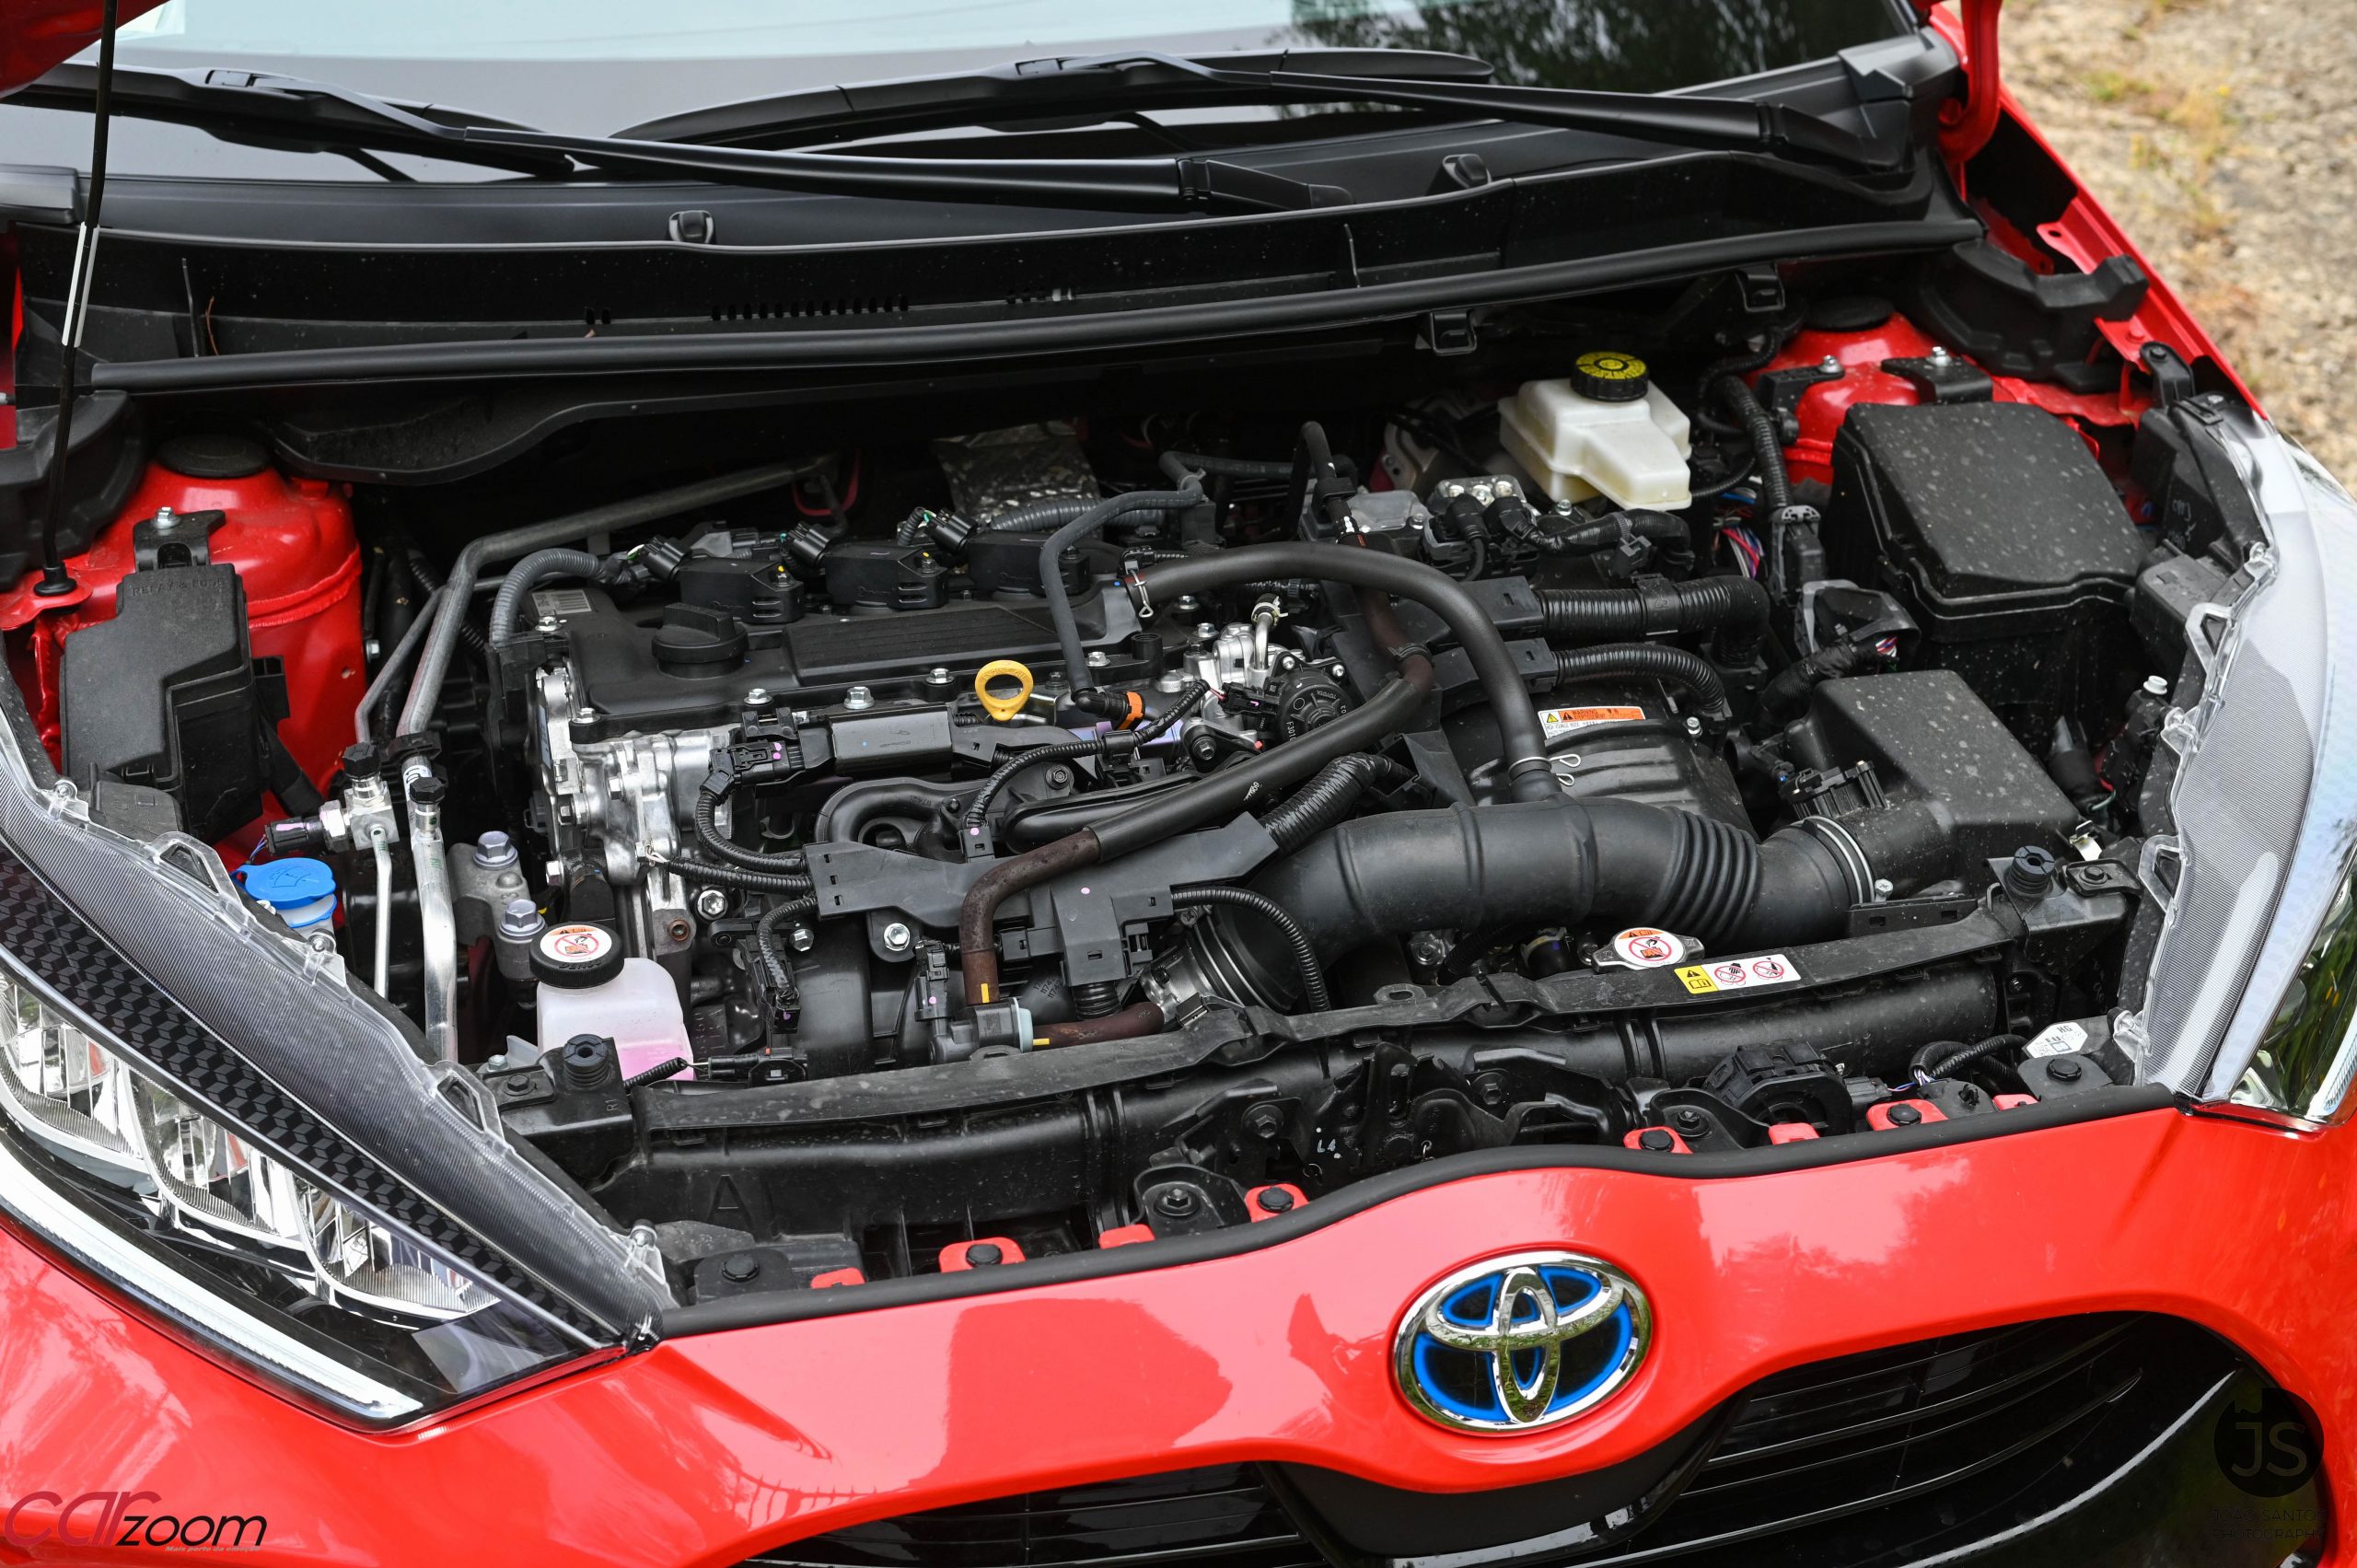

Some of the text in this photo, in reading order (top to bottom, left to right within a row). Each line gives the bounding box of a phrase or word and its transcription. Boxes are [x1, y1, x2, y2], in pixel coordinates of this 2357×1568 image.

[131, 581, 174, 597] RELAY
[1316, 690, 1337, 700] TOYOTA
[559, 959, 602, 970] DENSO
